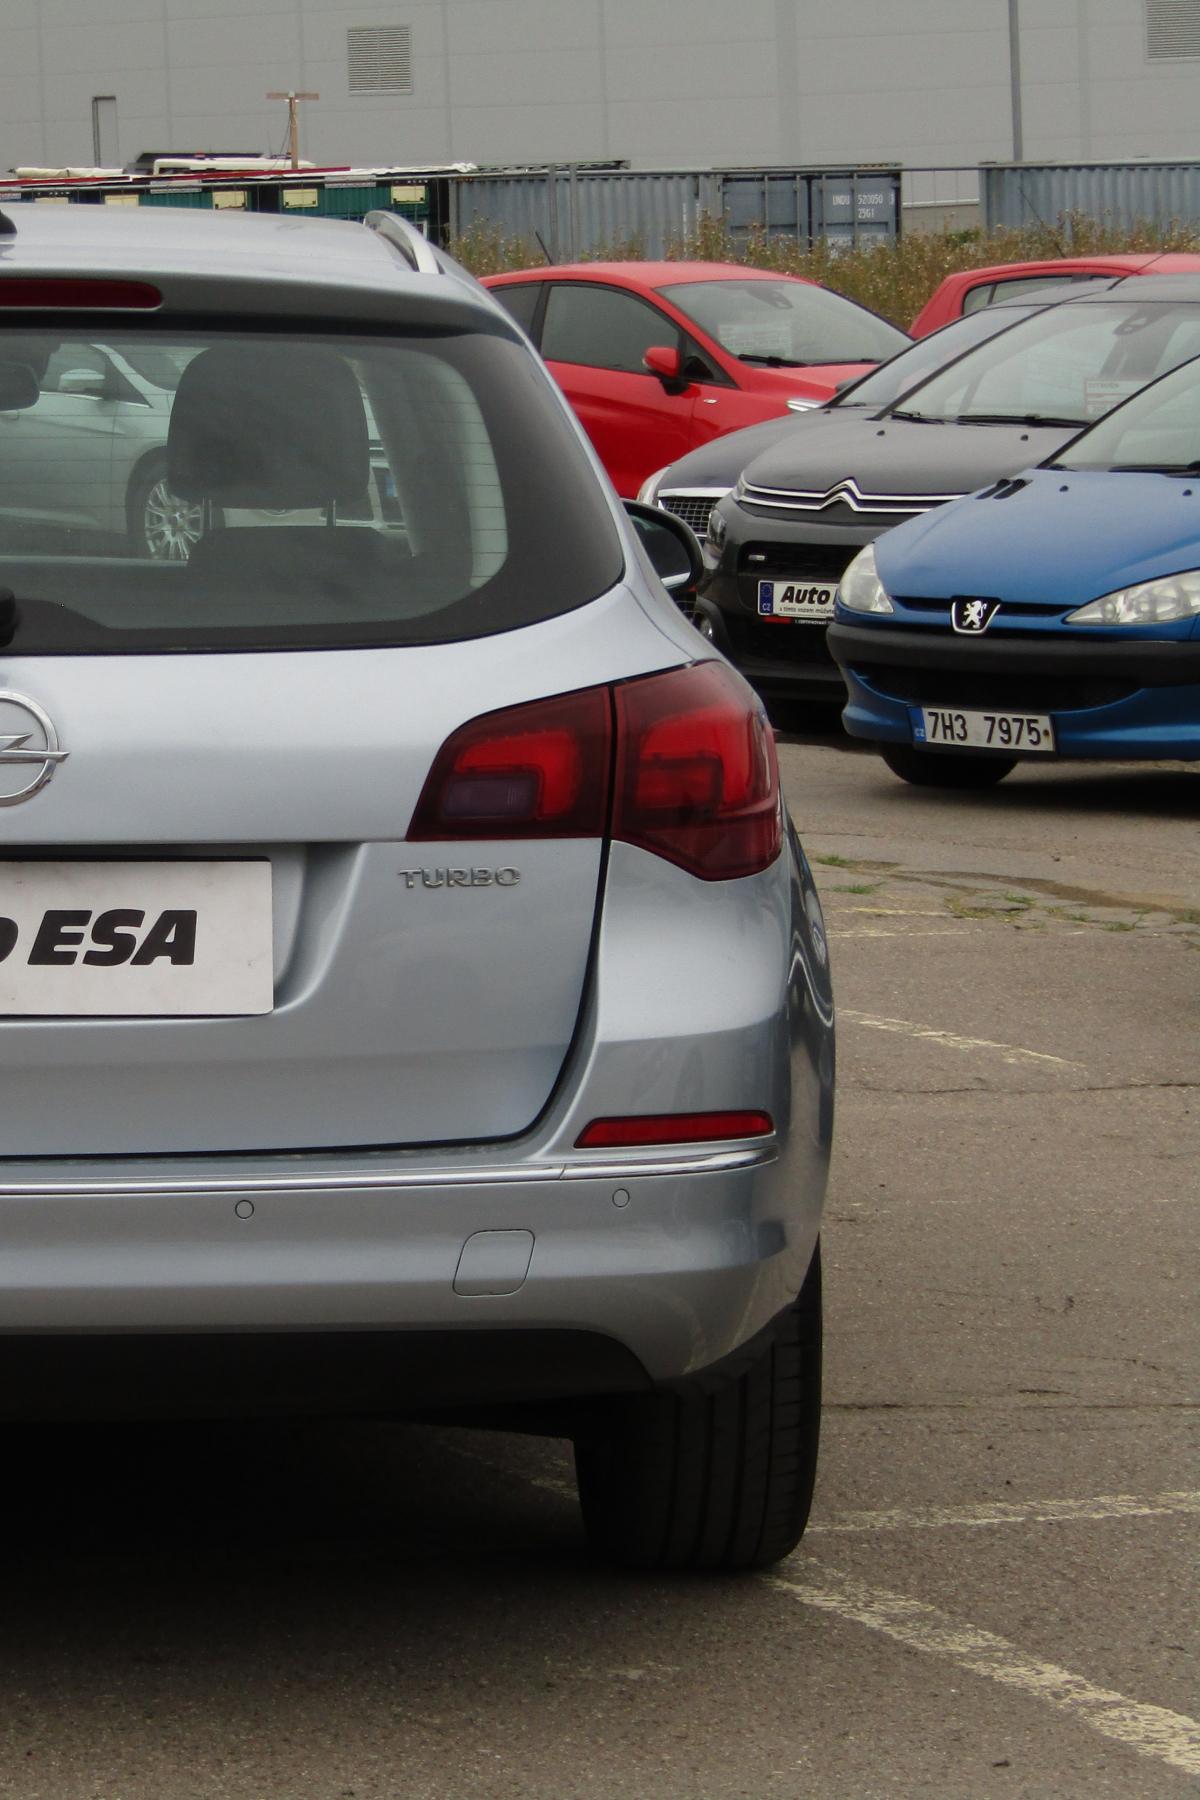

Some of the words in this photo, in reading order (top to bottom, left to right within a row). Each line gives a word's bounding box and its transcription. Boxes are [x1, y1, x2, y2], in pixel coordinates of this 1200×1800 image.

[780, 585, 831, 606] Auto
[762, 602, 772, 612] CZ
[913, 727, 926, 738] CZ
[928, 711, 968, 742] 7H3
[984, 715, 1041, 746] 7975
[398, 866, 521, 889] TURBO
[26, 908, 198, 967] ESA
